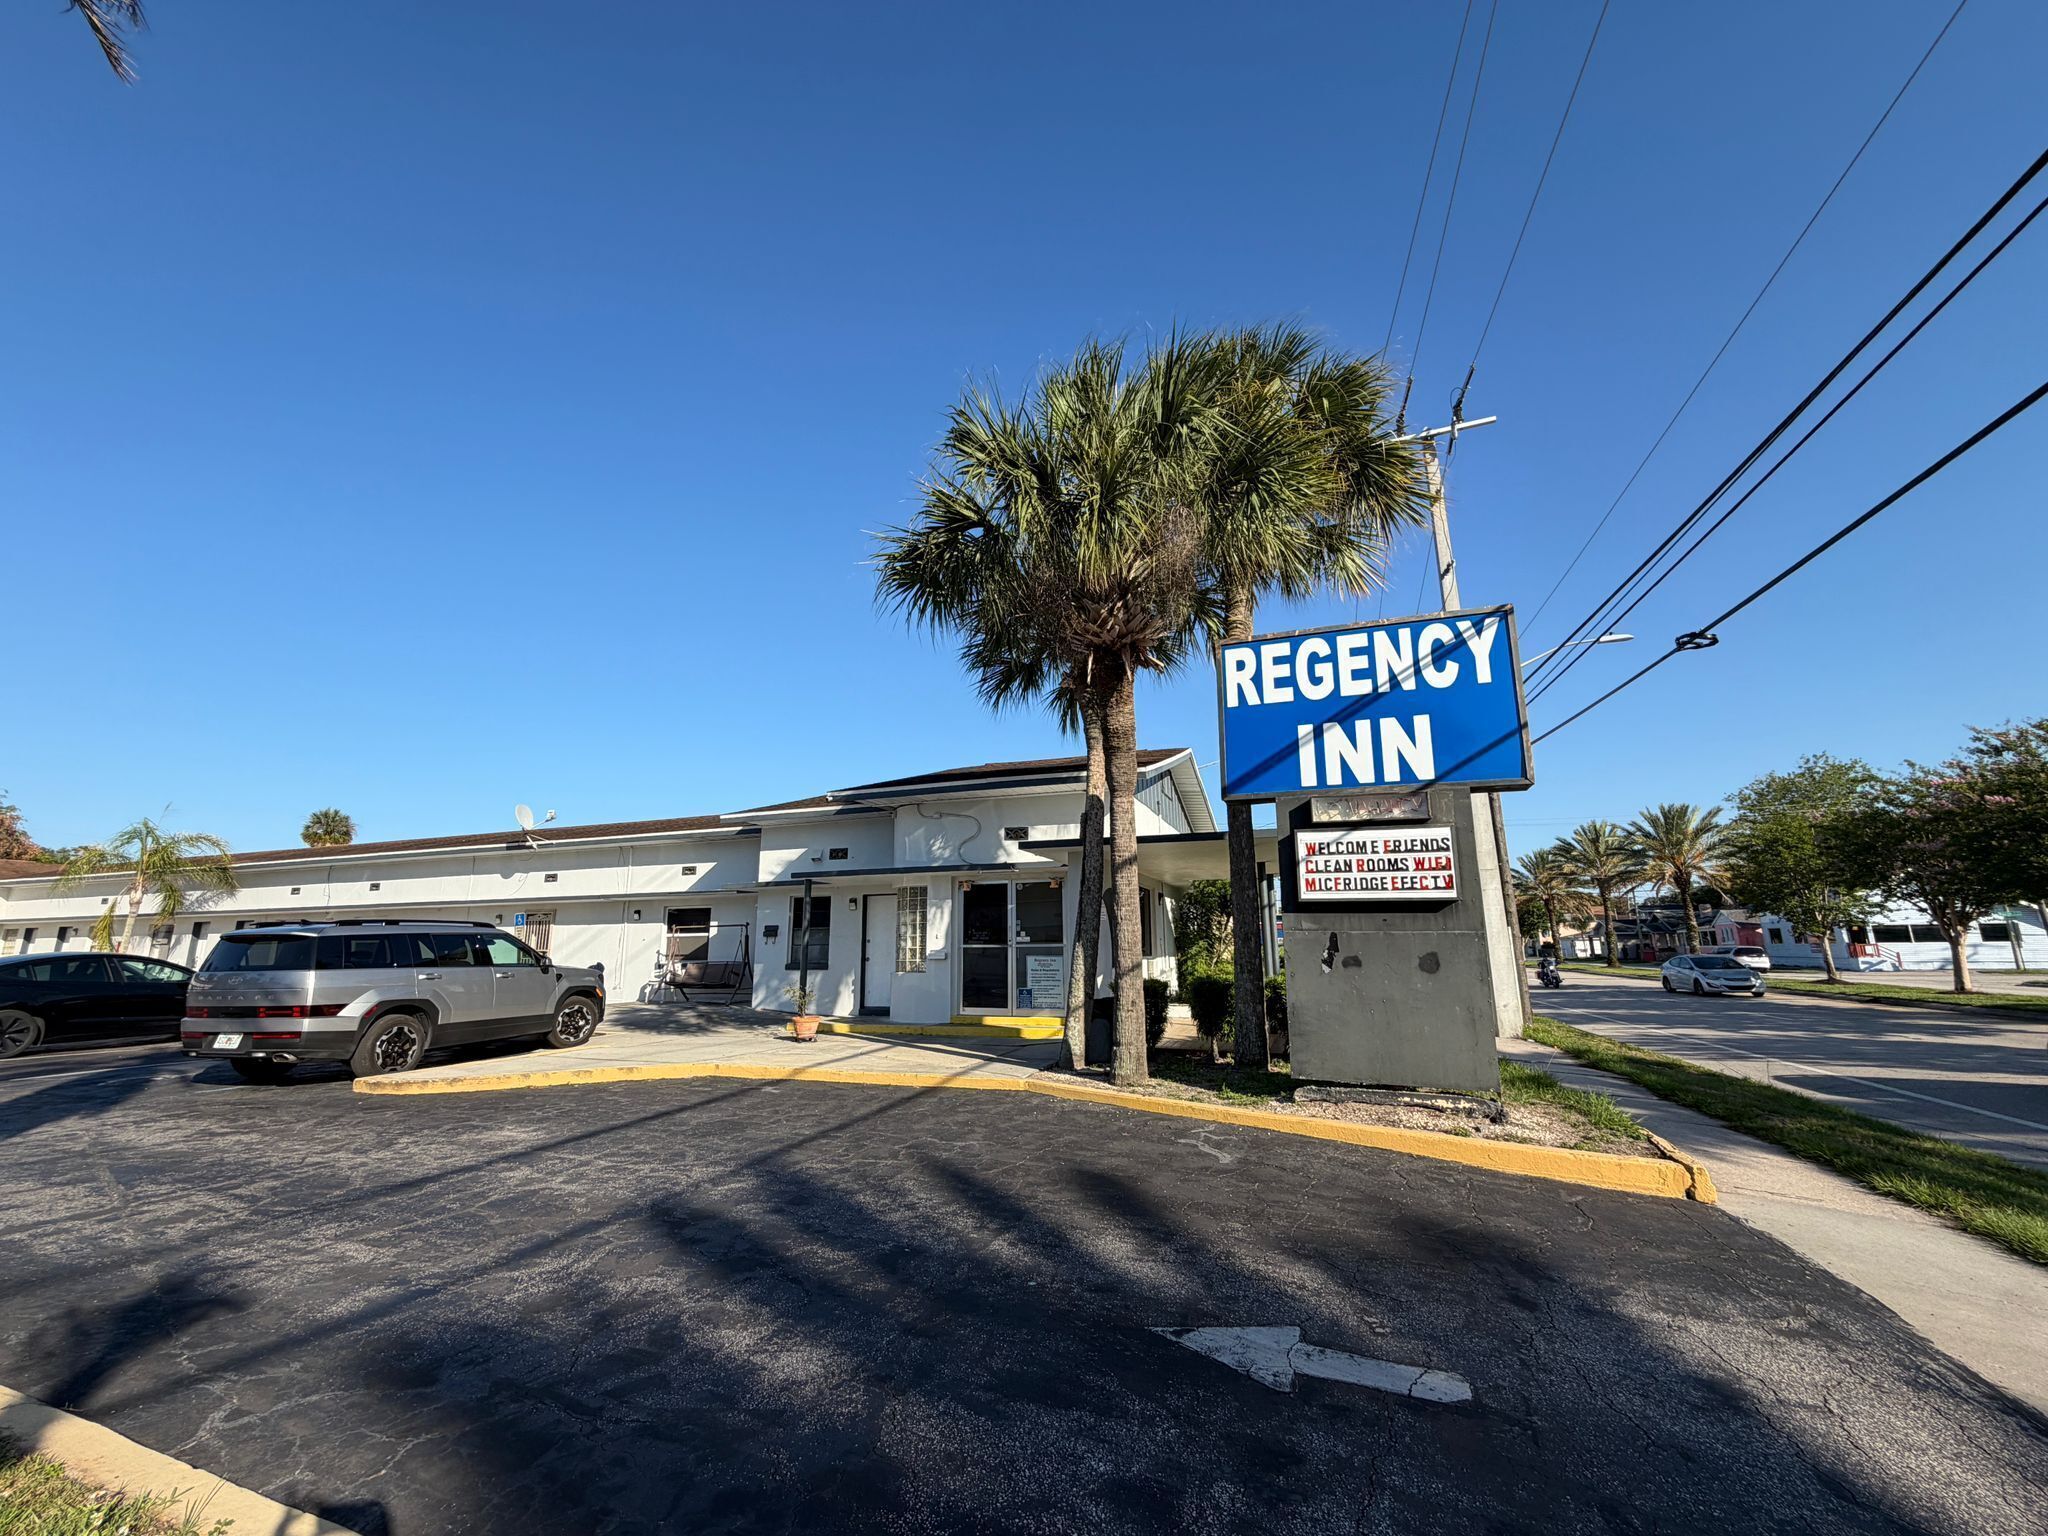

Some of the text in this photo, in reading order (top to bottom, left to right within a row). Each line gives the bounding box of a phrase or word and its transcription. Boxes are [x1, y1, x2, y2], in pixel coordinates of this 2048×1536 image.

[1224, 617, 1500, 708] REGENCY
[1297, 714, 1436, 787] INN
[1305, 840, 1380, 856] WELCOME
[1305, 859, 1354, 873] CLEAN
[1356, 858, 1409, 872] ROOMS
